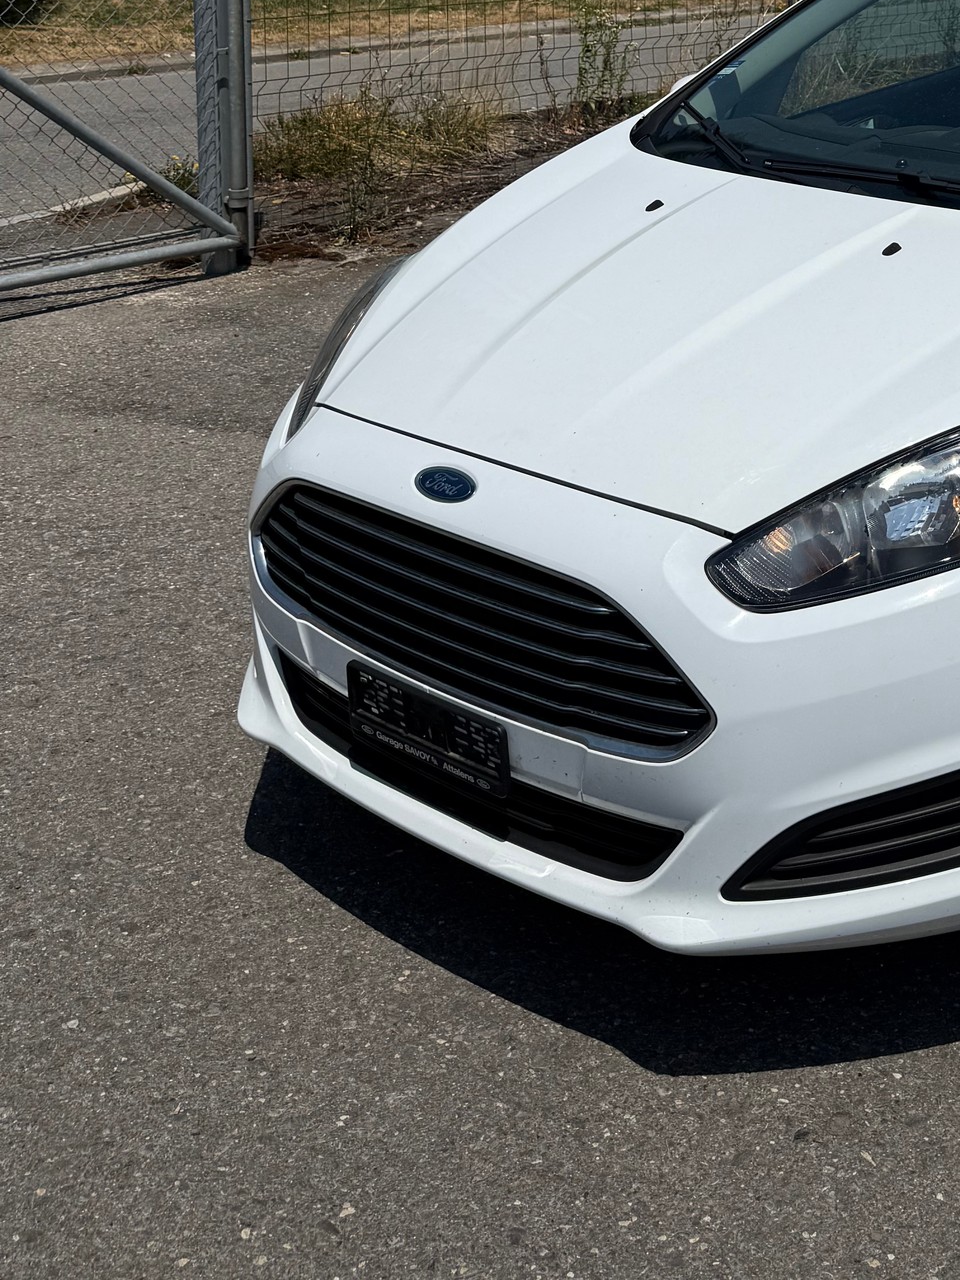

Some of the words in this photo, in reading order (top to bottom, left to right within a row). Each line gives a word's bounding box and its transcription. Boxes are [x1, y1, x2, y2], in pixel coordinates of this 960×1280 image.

[425, 472, 462, 495] Ford
[376, 731, 403, 749] Garage
[404, 744, 431, 761] SAVOY
[443, 762, 474, 782] Attalens
